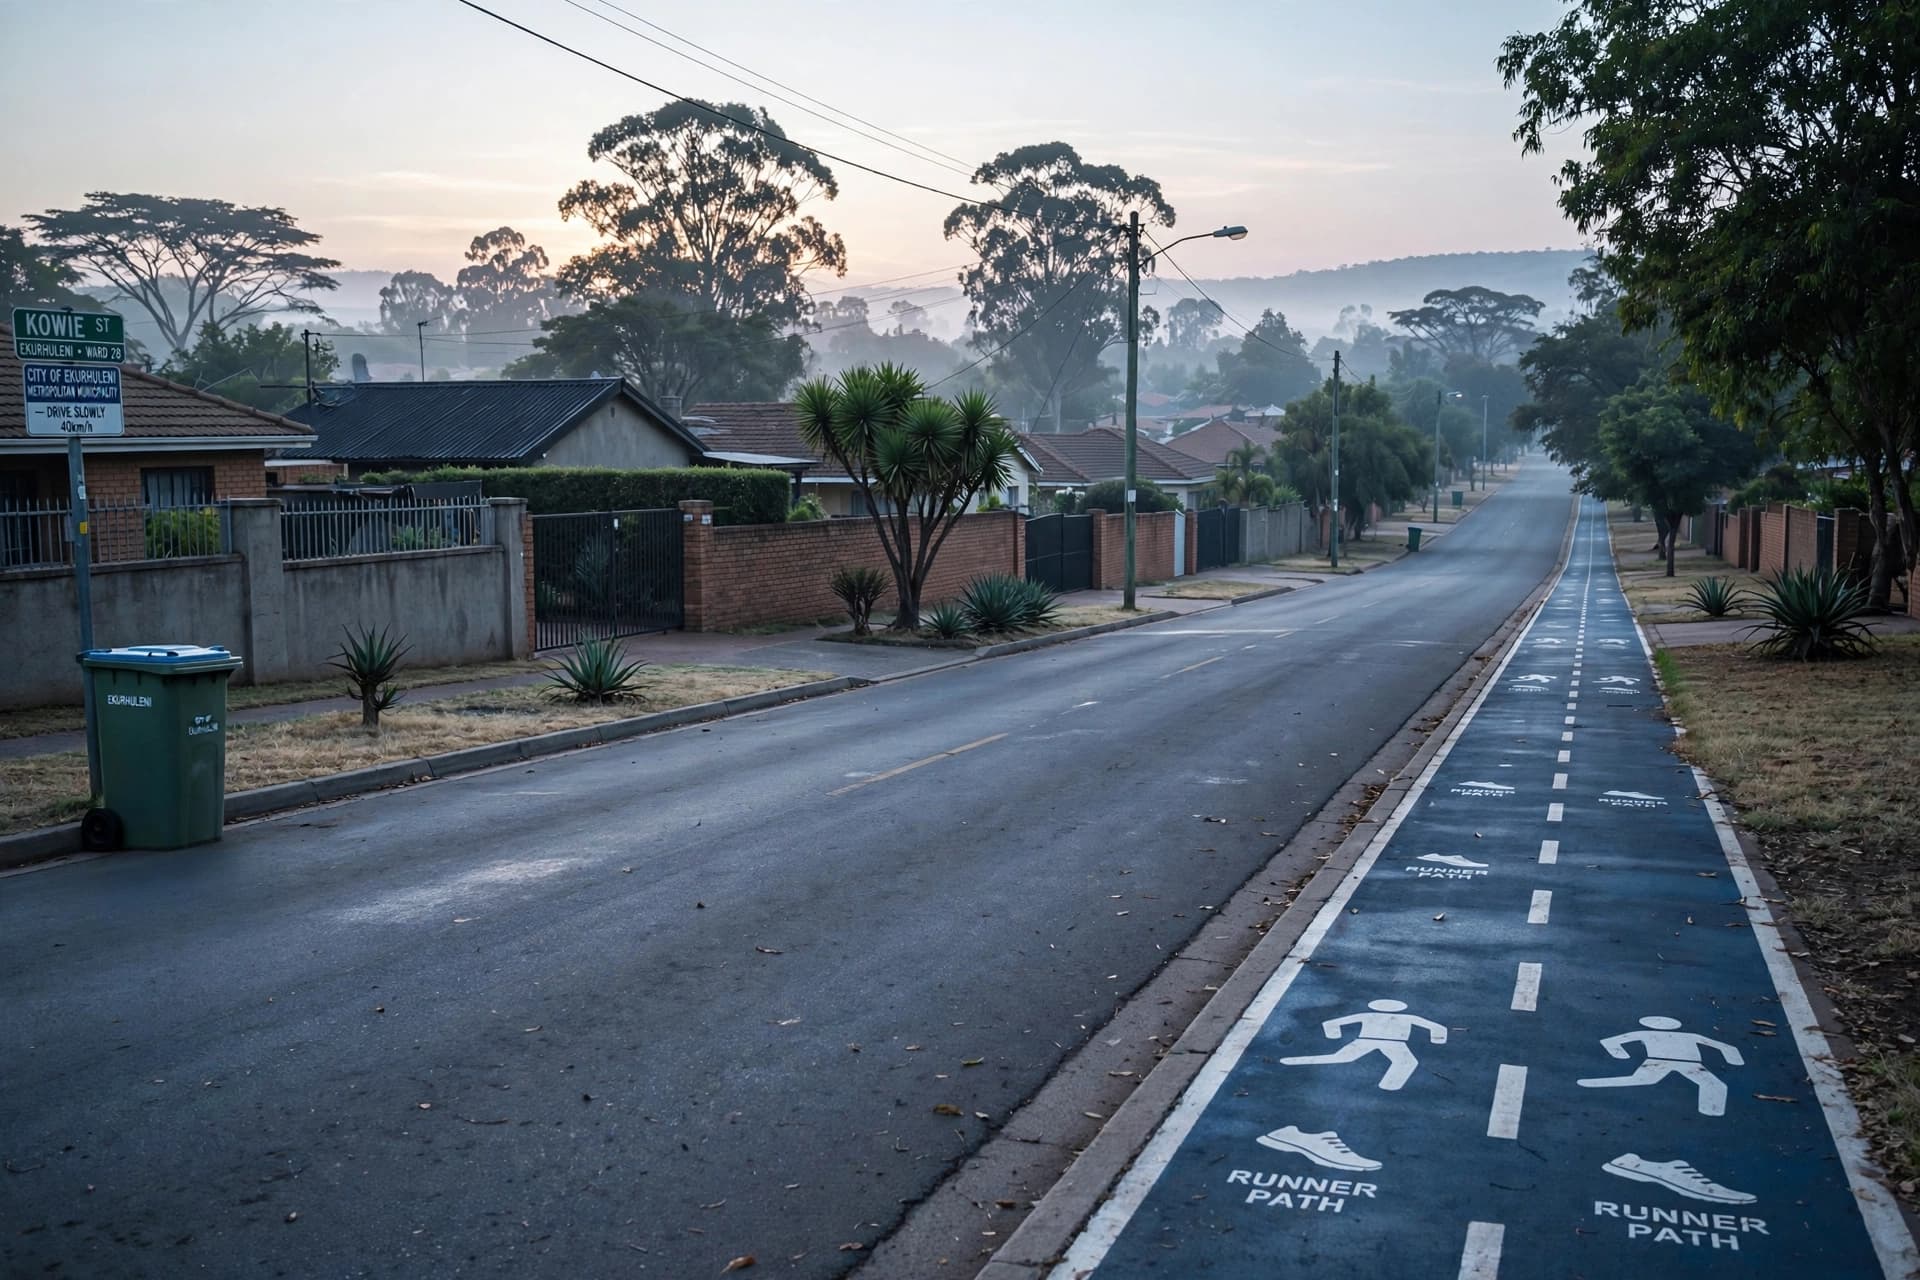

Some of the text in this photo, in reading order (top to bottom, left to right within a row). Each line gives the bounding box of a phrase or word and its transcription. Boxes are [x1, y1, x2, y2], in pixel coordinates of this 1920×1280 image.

[26, 313, 110, 338] KOWIE ST
[20, 343, 121, 359] EKURHULENI WARD 28
[27, 368, 116, 384] CITY OF EKURHULENI
[46, 406, 105, 418] DRIVE SLOWLY
[1227, 1169, 1378, 1198] RUNNER
[1245, 1189, 1344, 1213] PATH
[1594, 1201, 1770, 1235] RUNNER
[1628, 1223, 1740, 1251] PATH
